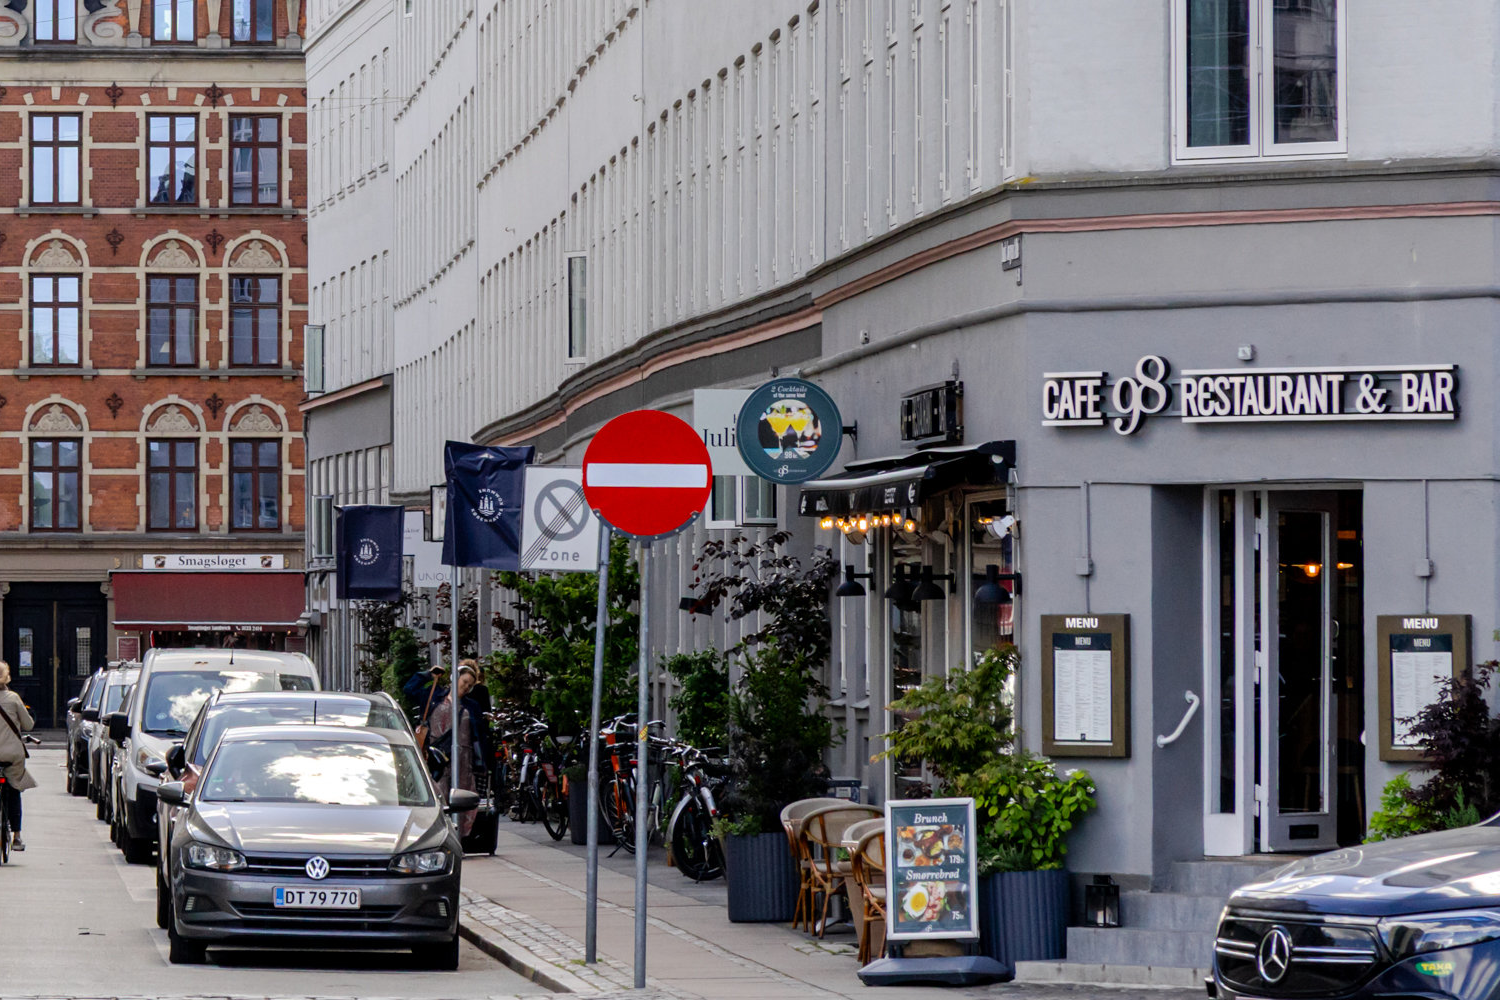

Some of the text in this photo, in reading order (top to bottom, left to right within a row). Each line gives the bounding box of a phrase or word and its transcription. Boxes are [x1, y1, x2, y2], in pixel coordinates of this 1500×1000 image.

[1043, 355, 1455, 436] CAFE 98 RESTAURANT & BAR
[702, 427, 737, 447] Juli
[539, 548, 580, 562] Zone
[178, 556, 246, 568] Smagsløget
[418, 572, 452, 582] UNIQU
[1065, 617, 1099, 629] MENU
[1402, 617, 1439, 629] MENU
[1074, 636, 1092, 646] MENU
[1412, 637, 1431, 648] MENU
[914, 813, 948, 824] Brunch
[906, 869, 960, 880] Smørrebrød
[285, 891, 358, 905] DT 79 770
